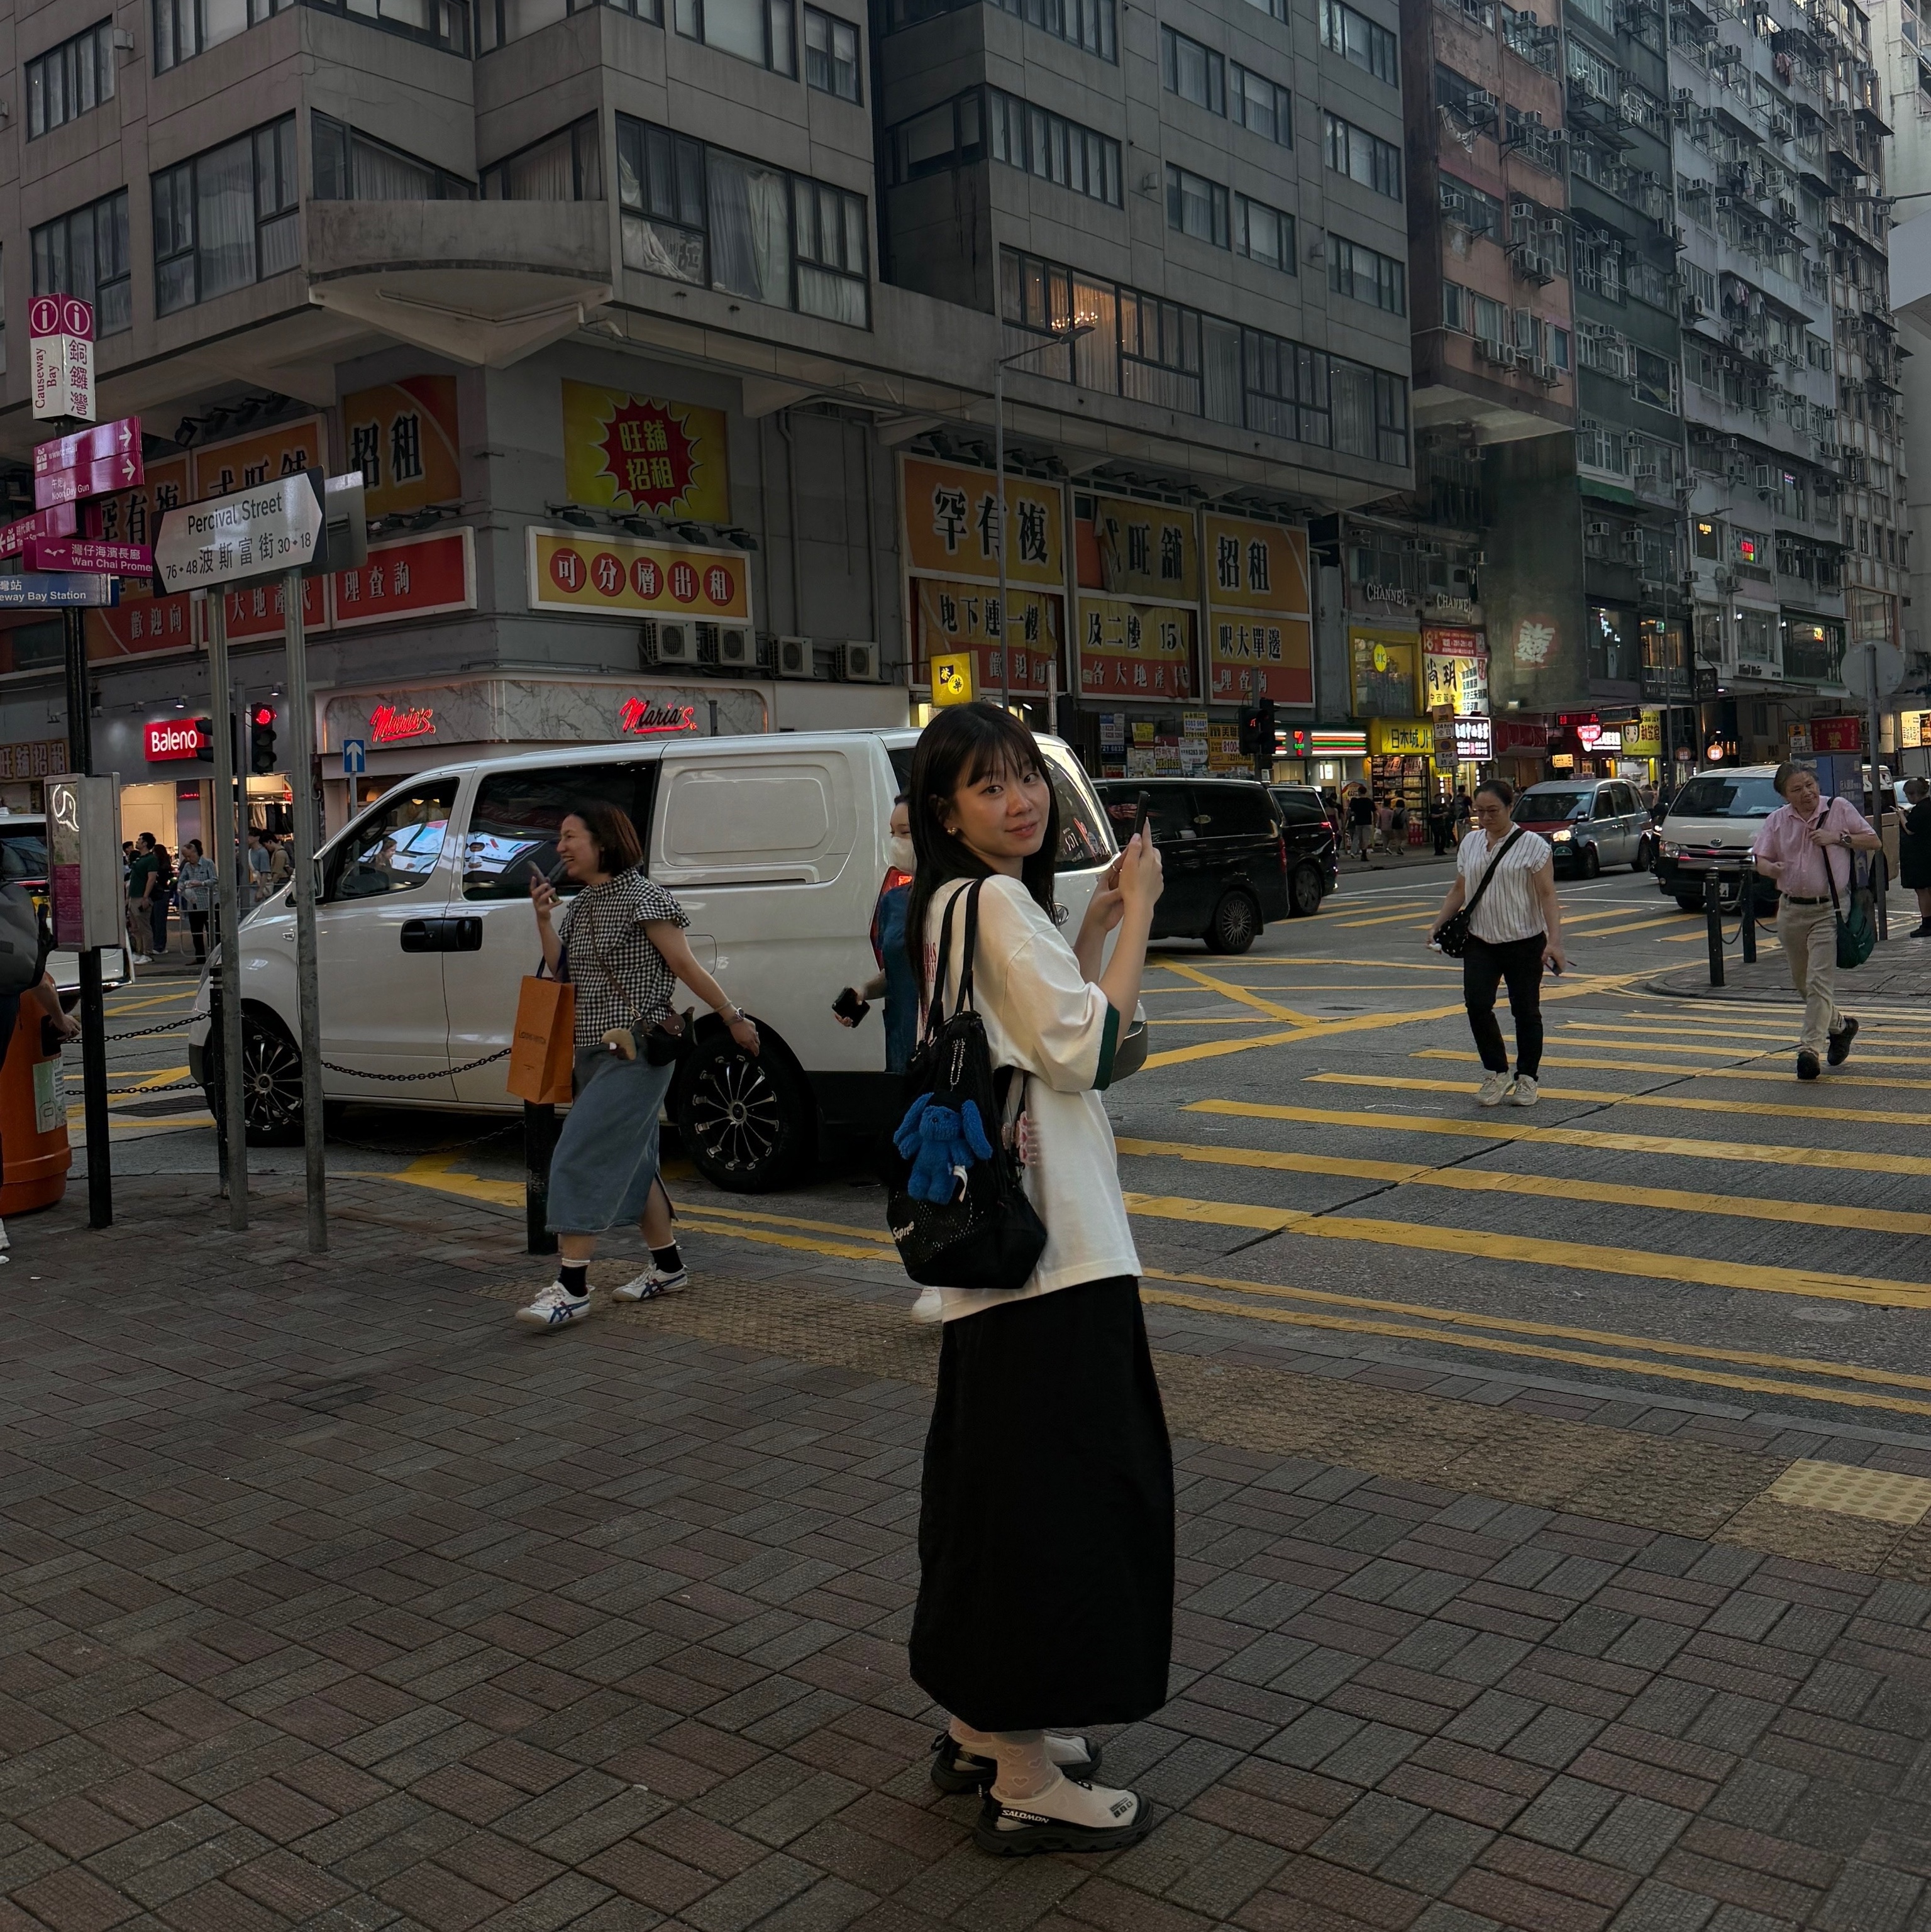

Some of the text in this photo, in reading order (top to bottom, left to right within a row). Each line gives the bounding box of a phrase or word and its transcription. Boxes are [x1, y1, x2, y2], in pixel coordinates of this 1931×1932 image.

[35, 348, 46, 408] Causeway
[47, 366, 59, 388] Bay
[69, 339, 88, 415] 銅鑼灣
[351, 413, 423, 489] 招租
[626, 457, 675, 490] 招租
[52, 483, 89, 501] Noon Day Gun
[188, 492, 282, 534] Percival Street
[72, 544, 140, 560] 灣仔海濱長廊
[72, 557, 93, 567] Wan
[96, 559, 118, 569] Chai
[166, 532, 311, 580] 76 48 波斯富街 30 18
[1218, 536, 1270, 591] 招租
[345, 560, 410, 602] 理查詢
[557, 554, 728, 600] 可分層出租
[28, 592, 47, 602] Bay
[50, 591, 86, 600] Station
[1367, 582, 1408, 607] CHANNEL
[619, 697, 694, 734] Maria's
[152, 727, 197, 752] Baleno
[1392, 729, 1419, 749] 日本城
[1002, 1809, 1049, 1824] SALOMON
